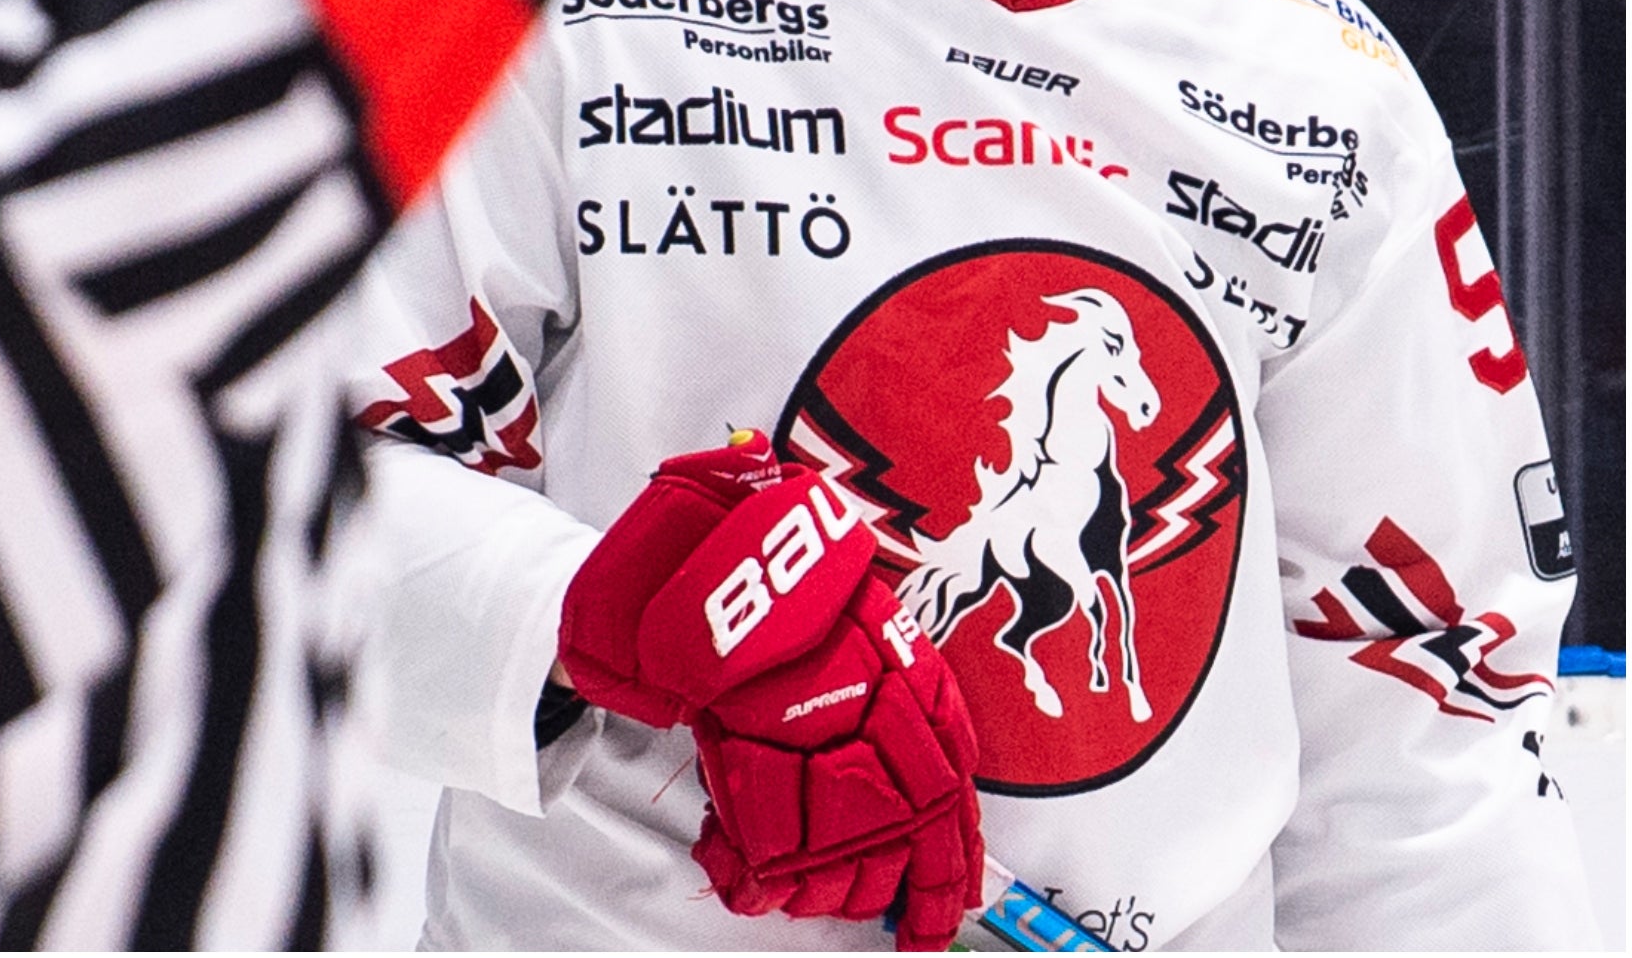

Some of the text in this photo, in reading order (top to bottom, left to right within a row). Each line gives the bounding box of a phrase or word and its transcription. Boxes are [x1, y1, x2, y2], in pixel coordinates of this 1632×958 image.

[684, 29, 832, 65] Personbilar
[579, 83, 847, 156] stadium
[577, 185, 852, 260] SLÄTTÖ
